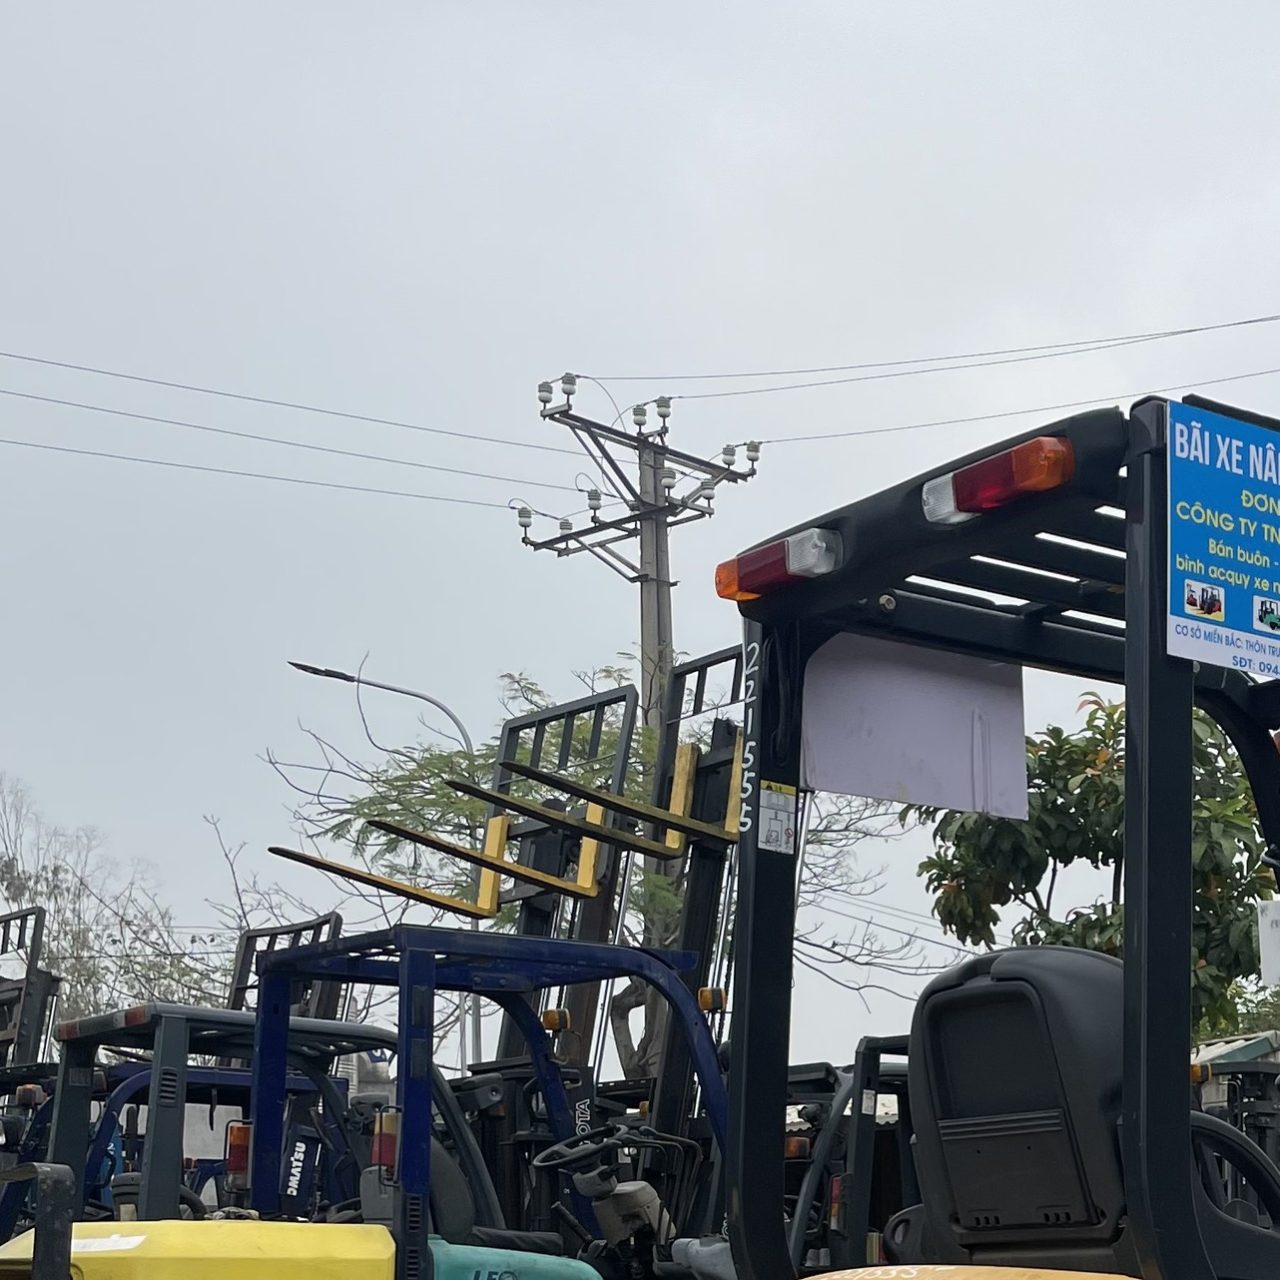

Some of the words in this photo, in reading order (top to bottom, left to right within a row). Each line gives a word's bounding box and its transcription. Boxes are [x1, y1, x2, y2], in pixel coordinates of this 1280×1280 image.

[1175, 421, 1210, 466] BÃI
[1216, 434, 1243, 475] XE
[1240, 490, 1280, 517] ĐƠN
[1176, 501, 1234, 532] CÔNG
[1238, 518, 1257, 537] TY
[1208, 538, 1233, 559] Bán
[1237, 546, 1270, 568] buôn
[1176, 553, 1204, 575] bình
[1208, 565, 1250, 589] acquy
[1254, 577, 1269, 591] xe
[1175, 624, 1188, 635] CƠ
[1245, 640, 1266, 654] THÔN
[1232, 656, 1256, 670] SĐT:
